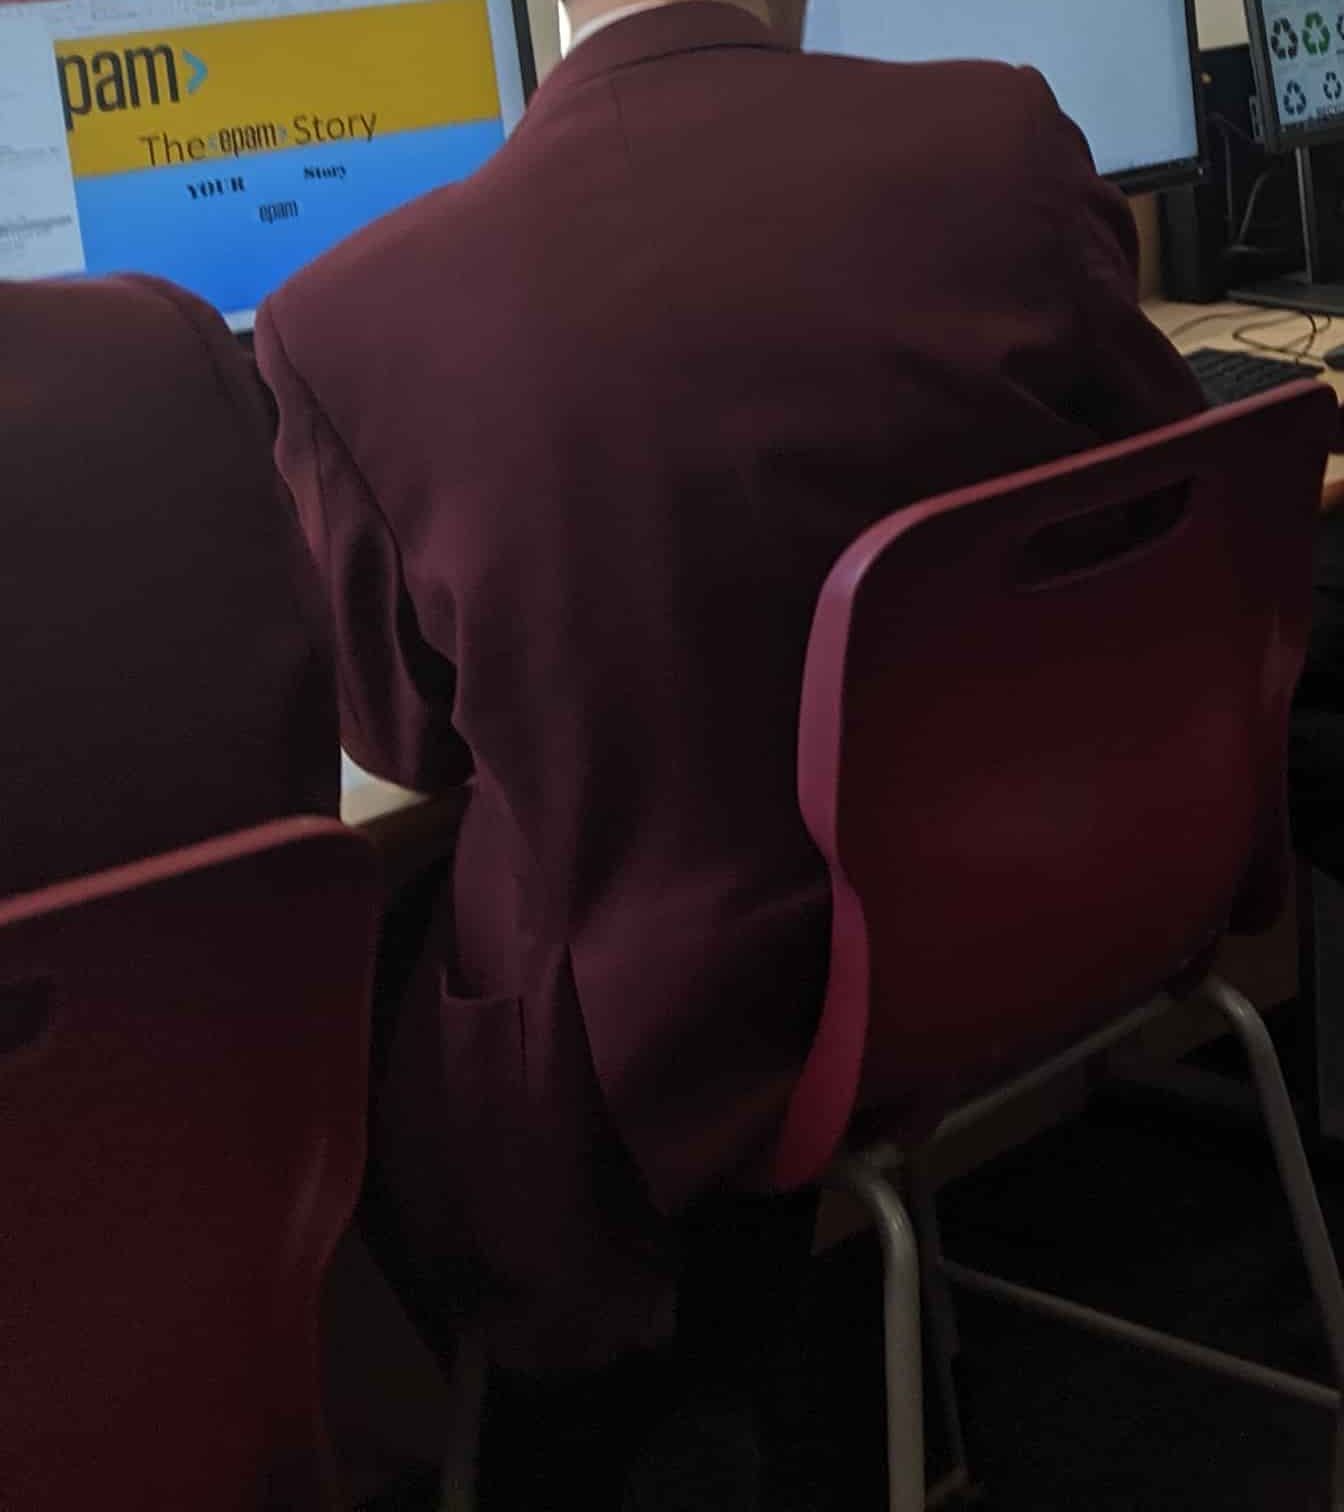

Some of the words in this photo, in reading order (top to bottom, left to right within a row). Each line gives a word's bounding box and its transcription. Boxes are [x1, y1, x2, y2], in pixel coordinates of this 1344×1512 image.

[139, 132, 206, 168] The
[217, 122, 278, 158] epam
[293, 111, 378, 145] Story
[185, 176, 245, 200] YOUR
[303, 164, 347, 181] Story
[258, 199, 299, 224] epam
